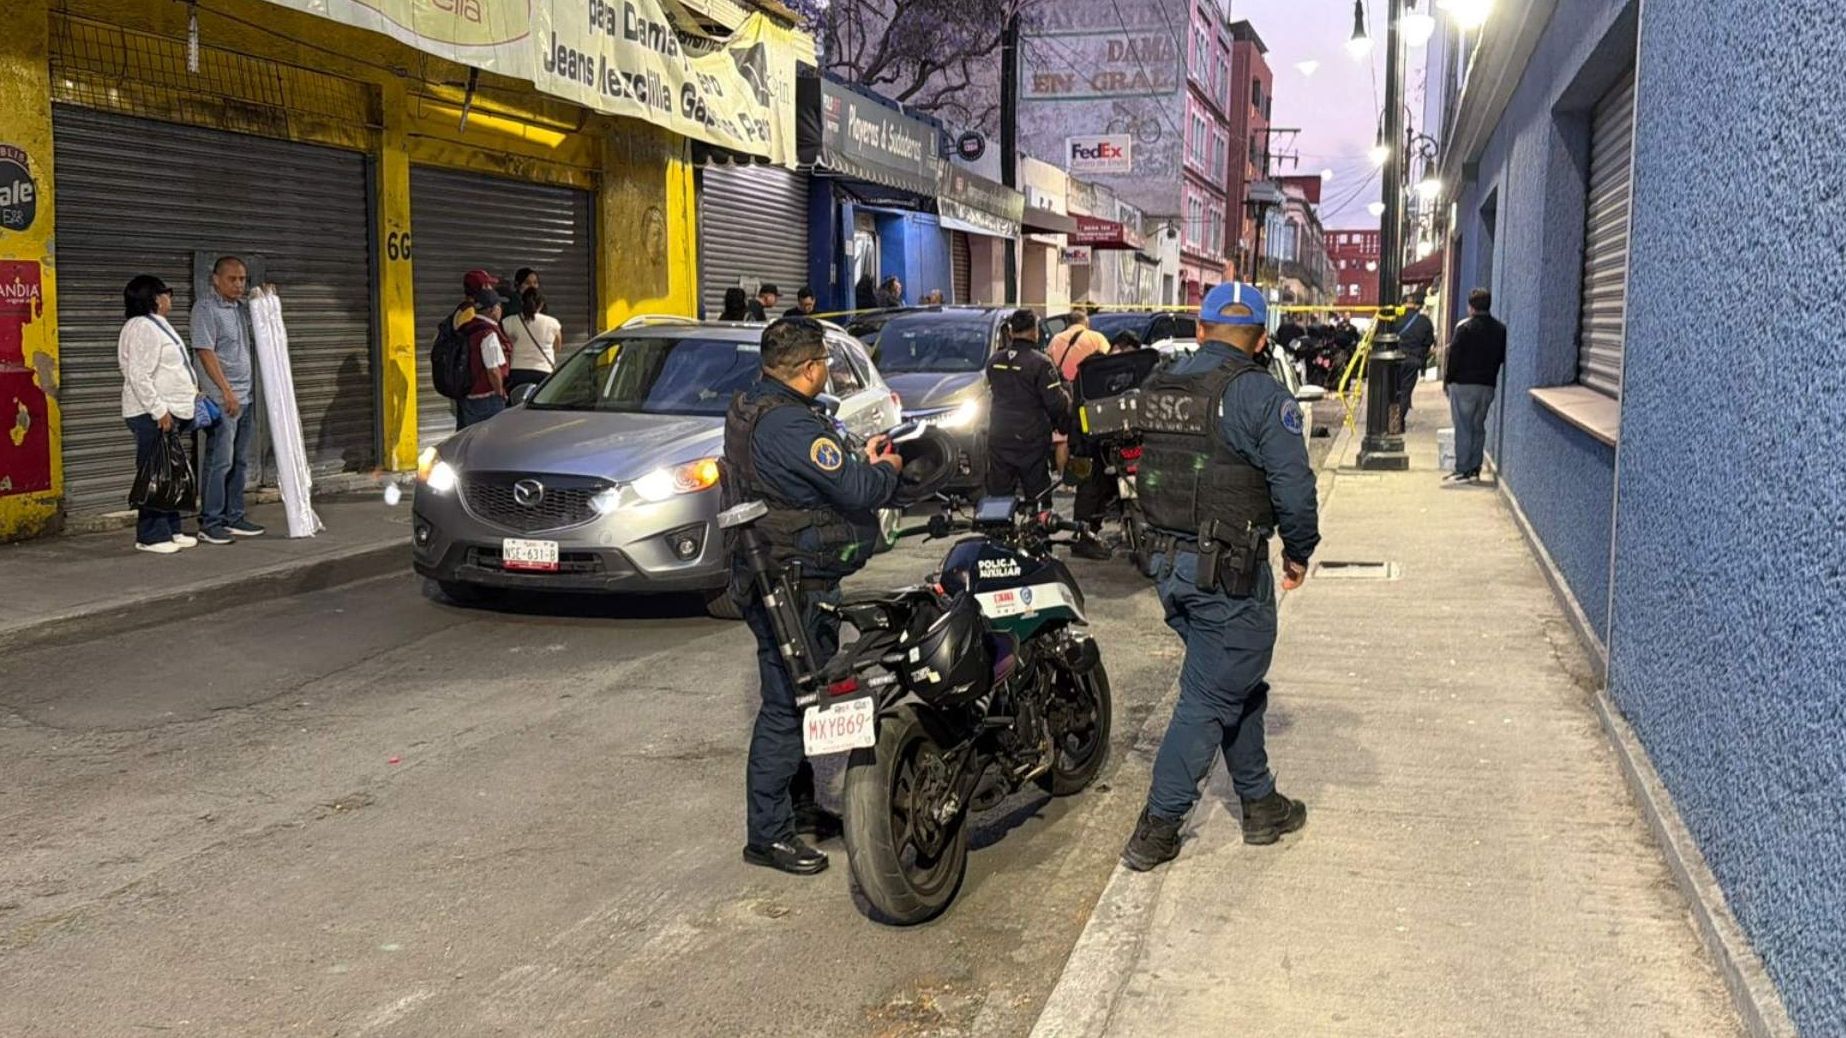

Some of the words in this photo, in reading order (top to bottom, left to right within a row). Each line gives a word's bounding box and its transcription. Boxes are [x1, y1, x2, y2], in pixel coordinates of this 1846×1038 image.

[543, 31, 594, 86] Jeans
[1072, 142, 1122, 160] FedEx
[1145, 394, 1193, 421] SSC
